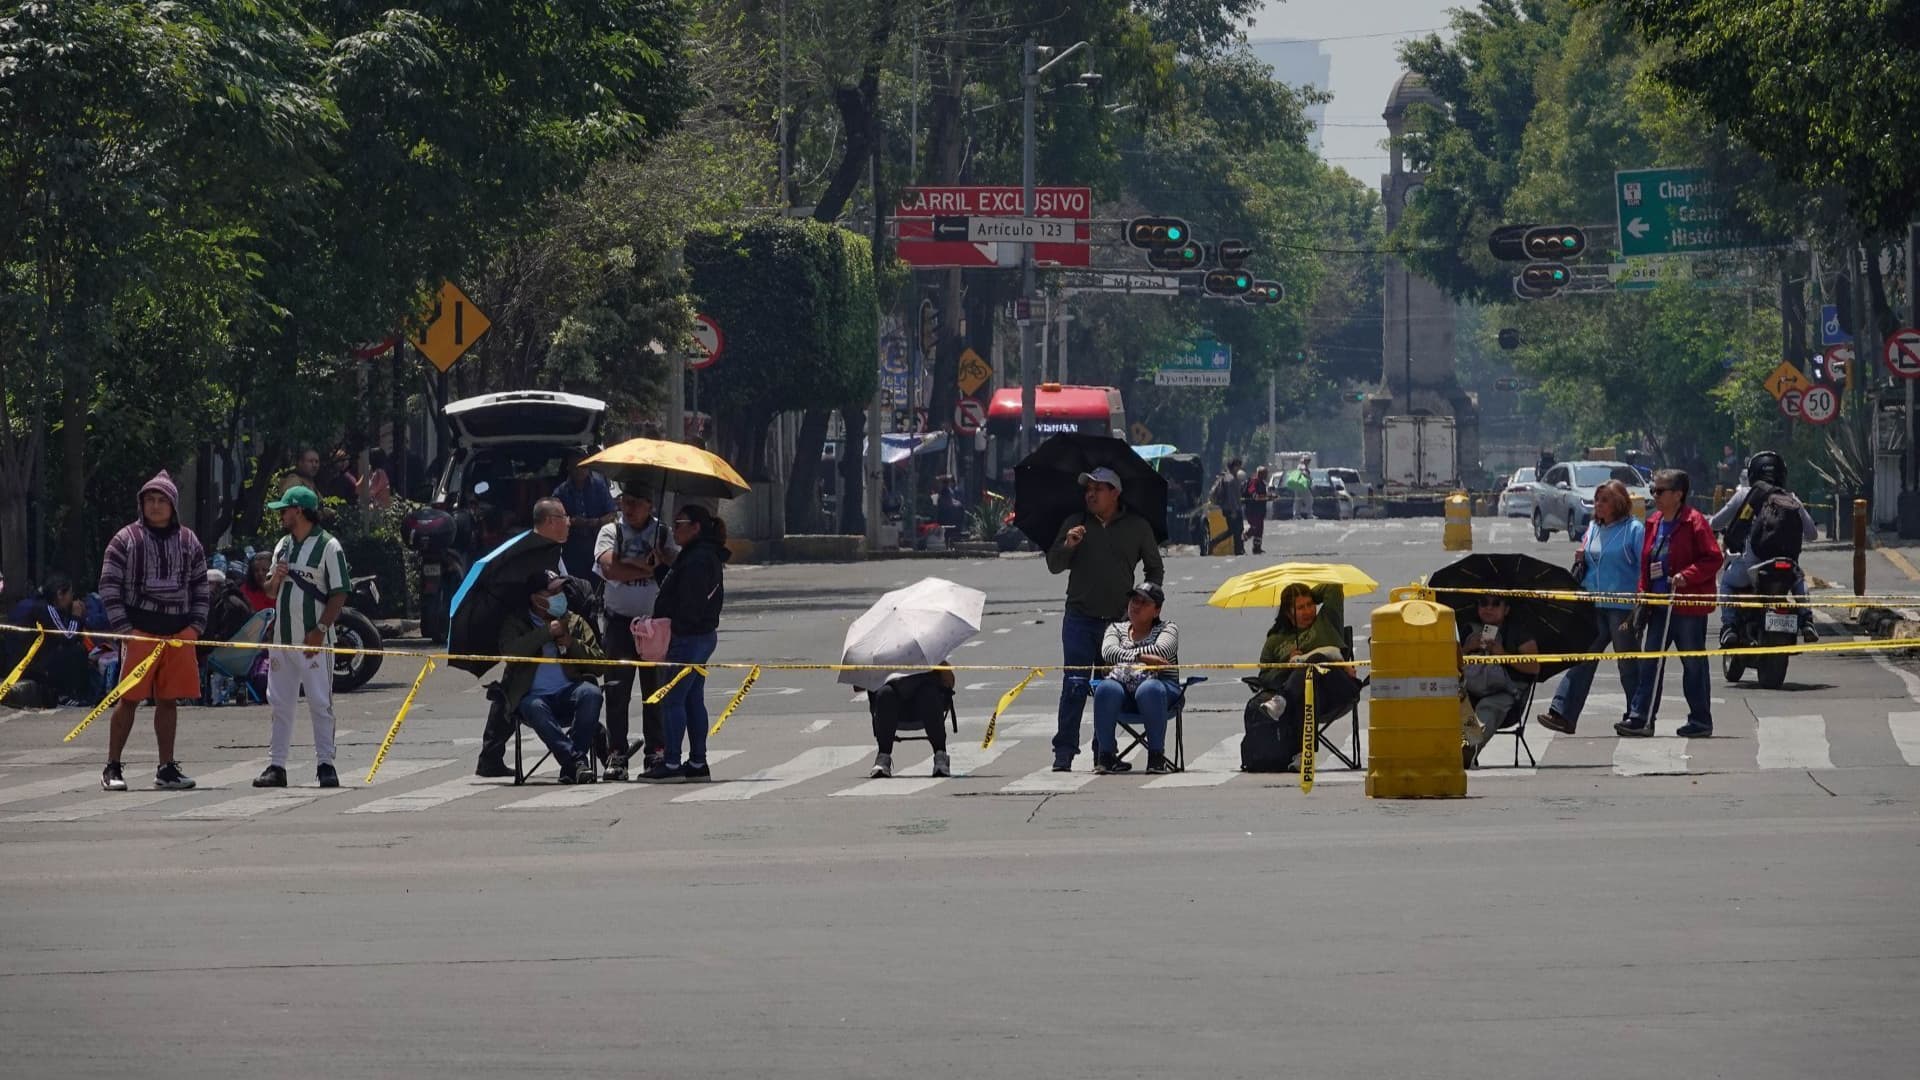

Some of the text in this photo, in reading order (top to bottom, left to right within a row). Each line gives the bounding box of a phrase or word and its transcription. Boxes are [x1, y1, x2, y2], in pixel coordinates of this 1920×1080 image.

[901, 192, 972, 211] CARRIL
[1040, 224, 1062, 237] 123
[1809, 391, 1830, 411] 50
[1303, 703, 1313, 782] PRECAUCION
